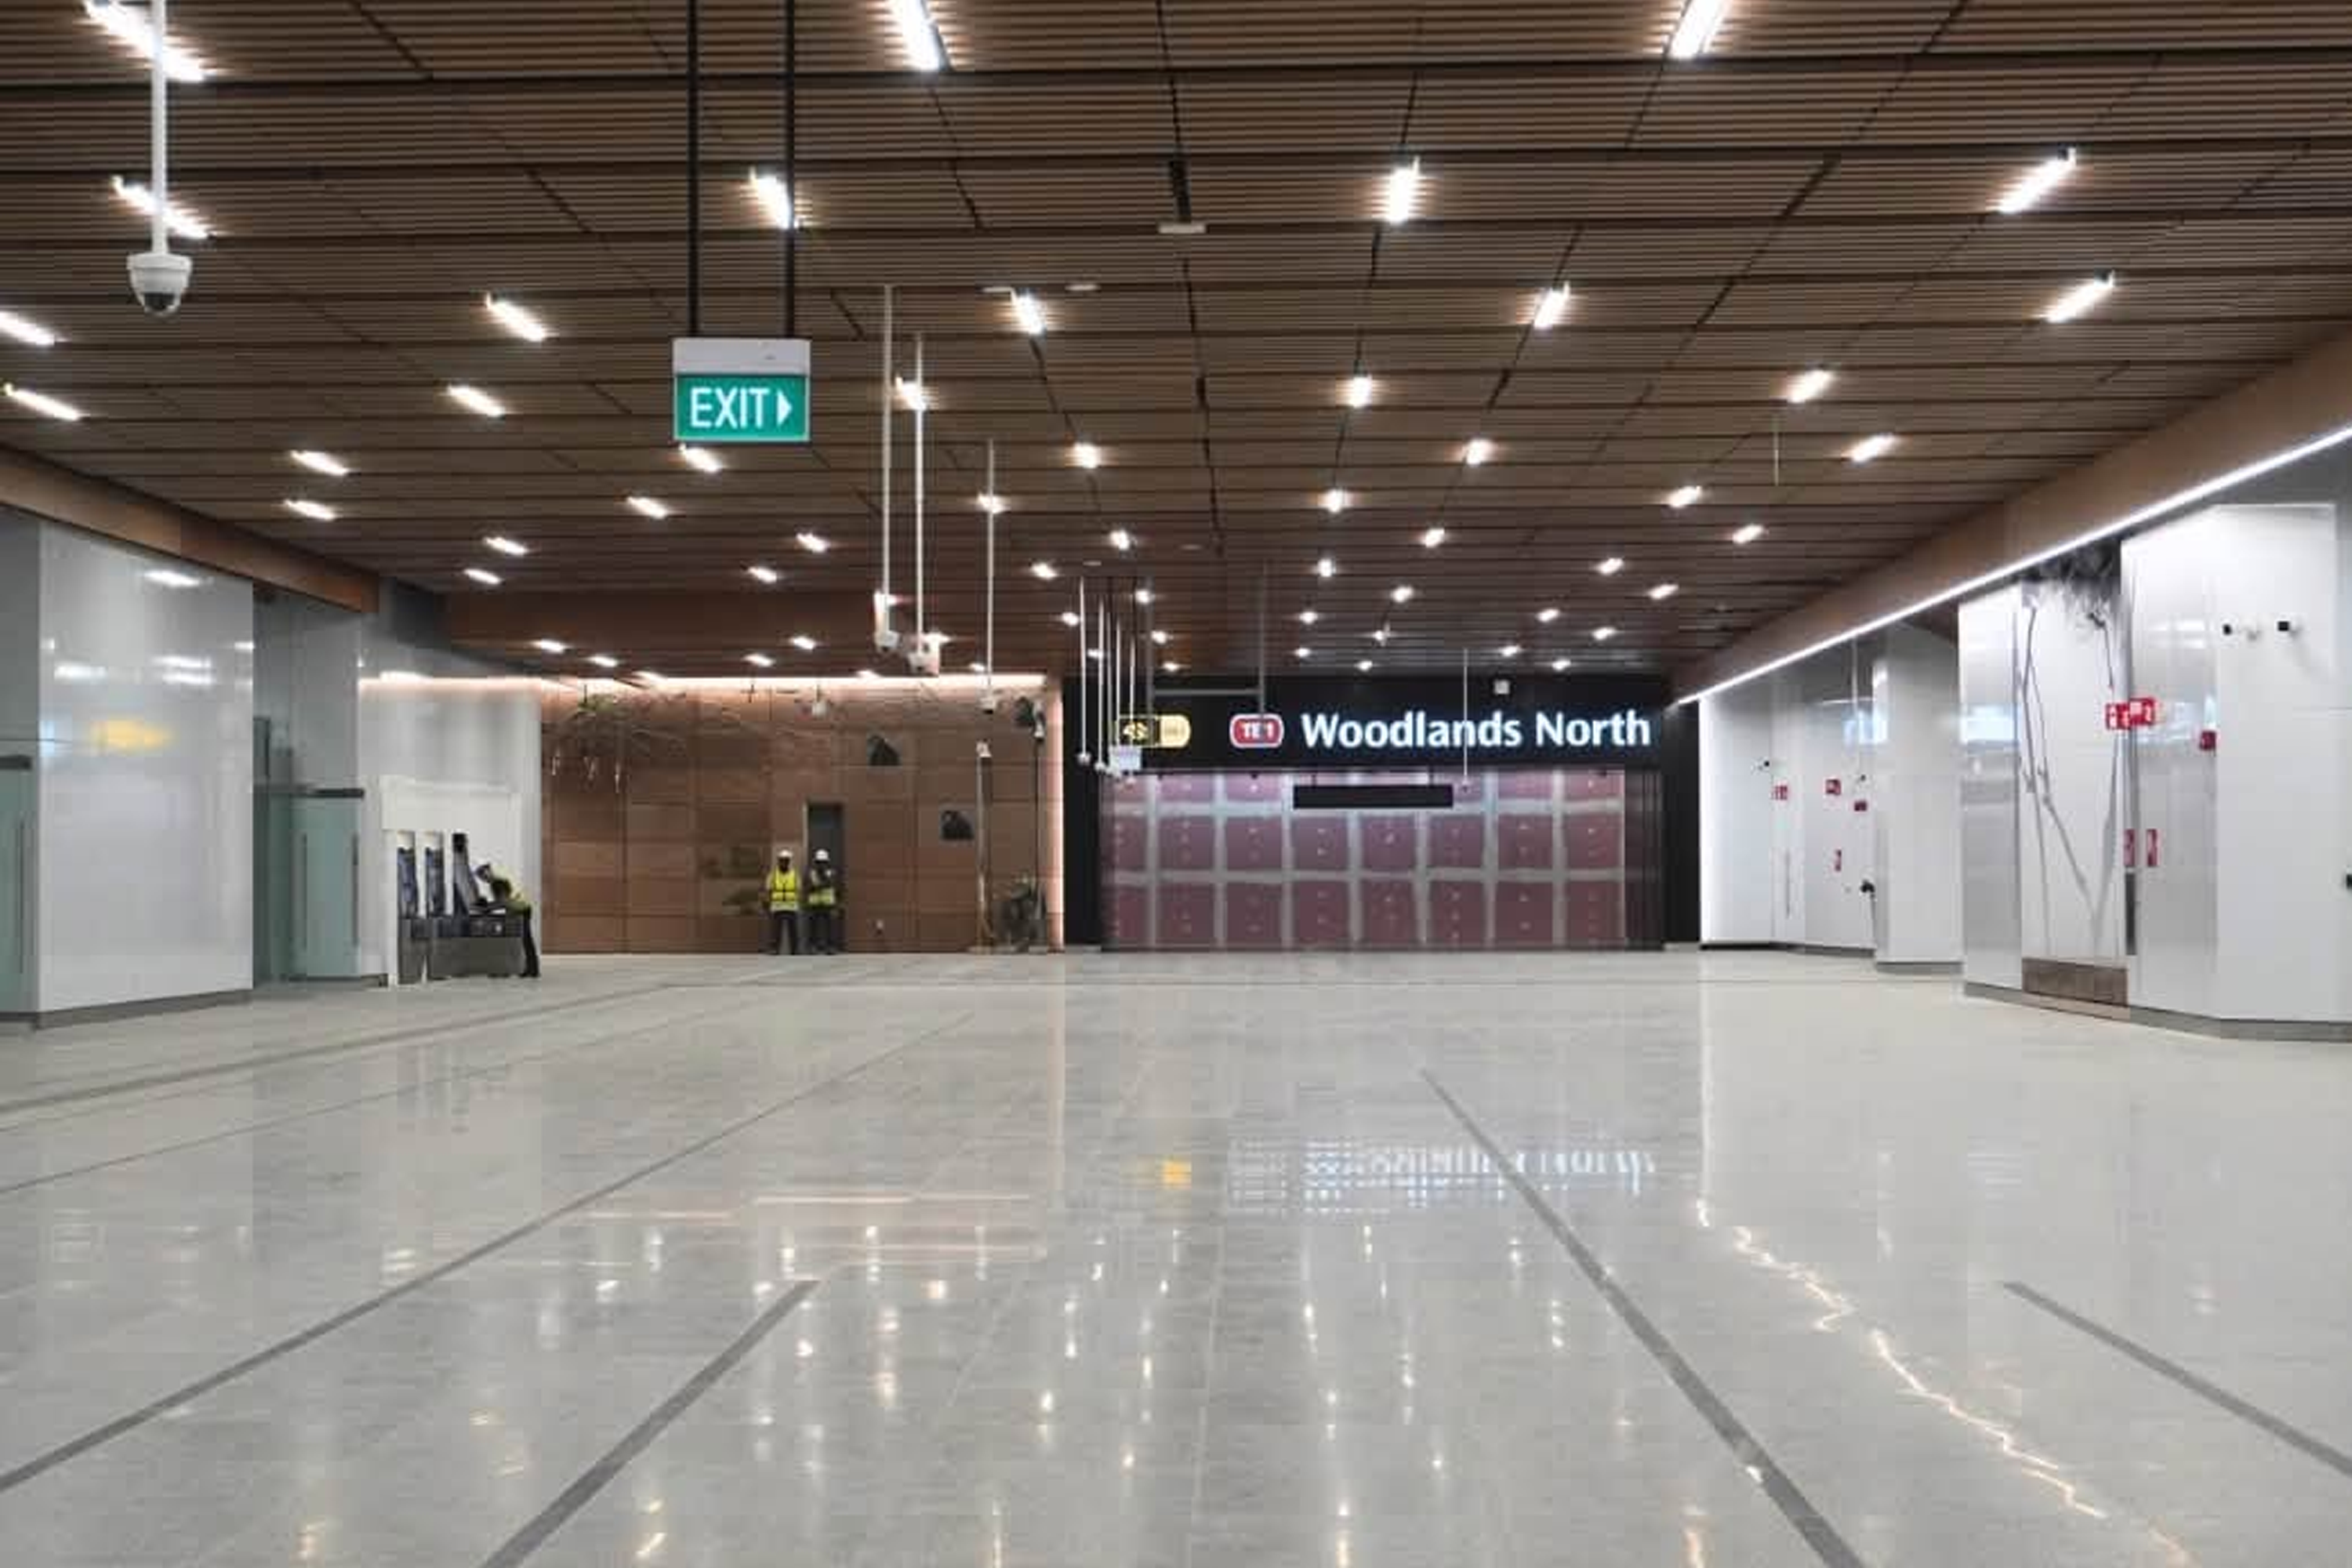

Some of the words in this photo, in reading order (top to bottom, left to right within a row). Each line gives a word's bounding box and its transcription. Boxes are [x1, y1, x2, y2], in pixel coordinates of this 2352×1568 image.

[691, 387, 771, 429] EXIT
[1301, 710, 1523, 748] Woodlands
[1536, 709, 1650, 746] North
